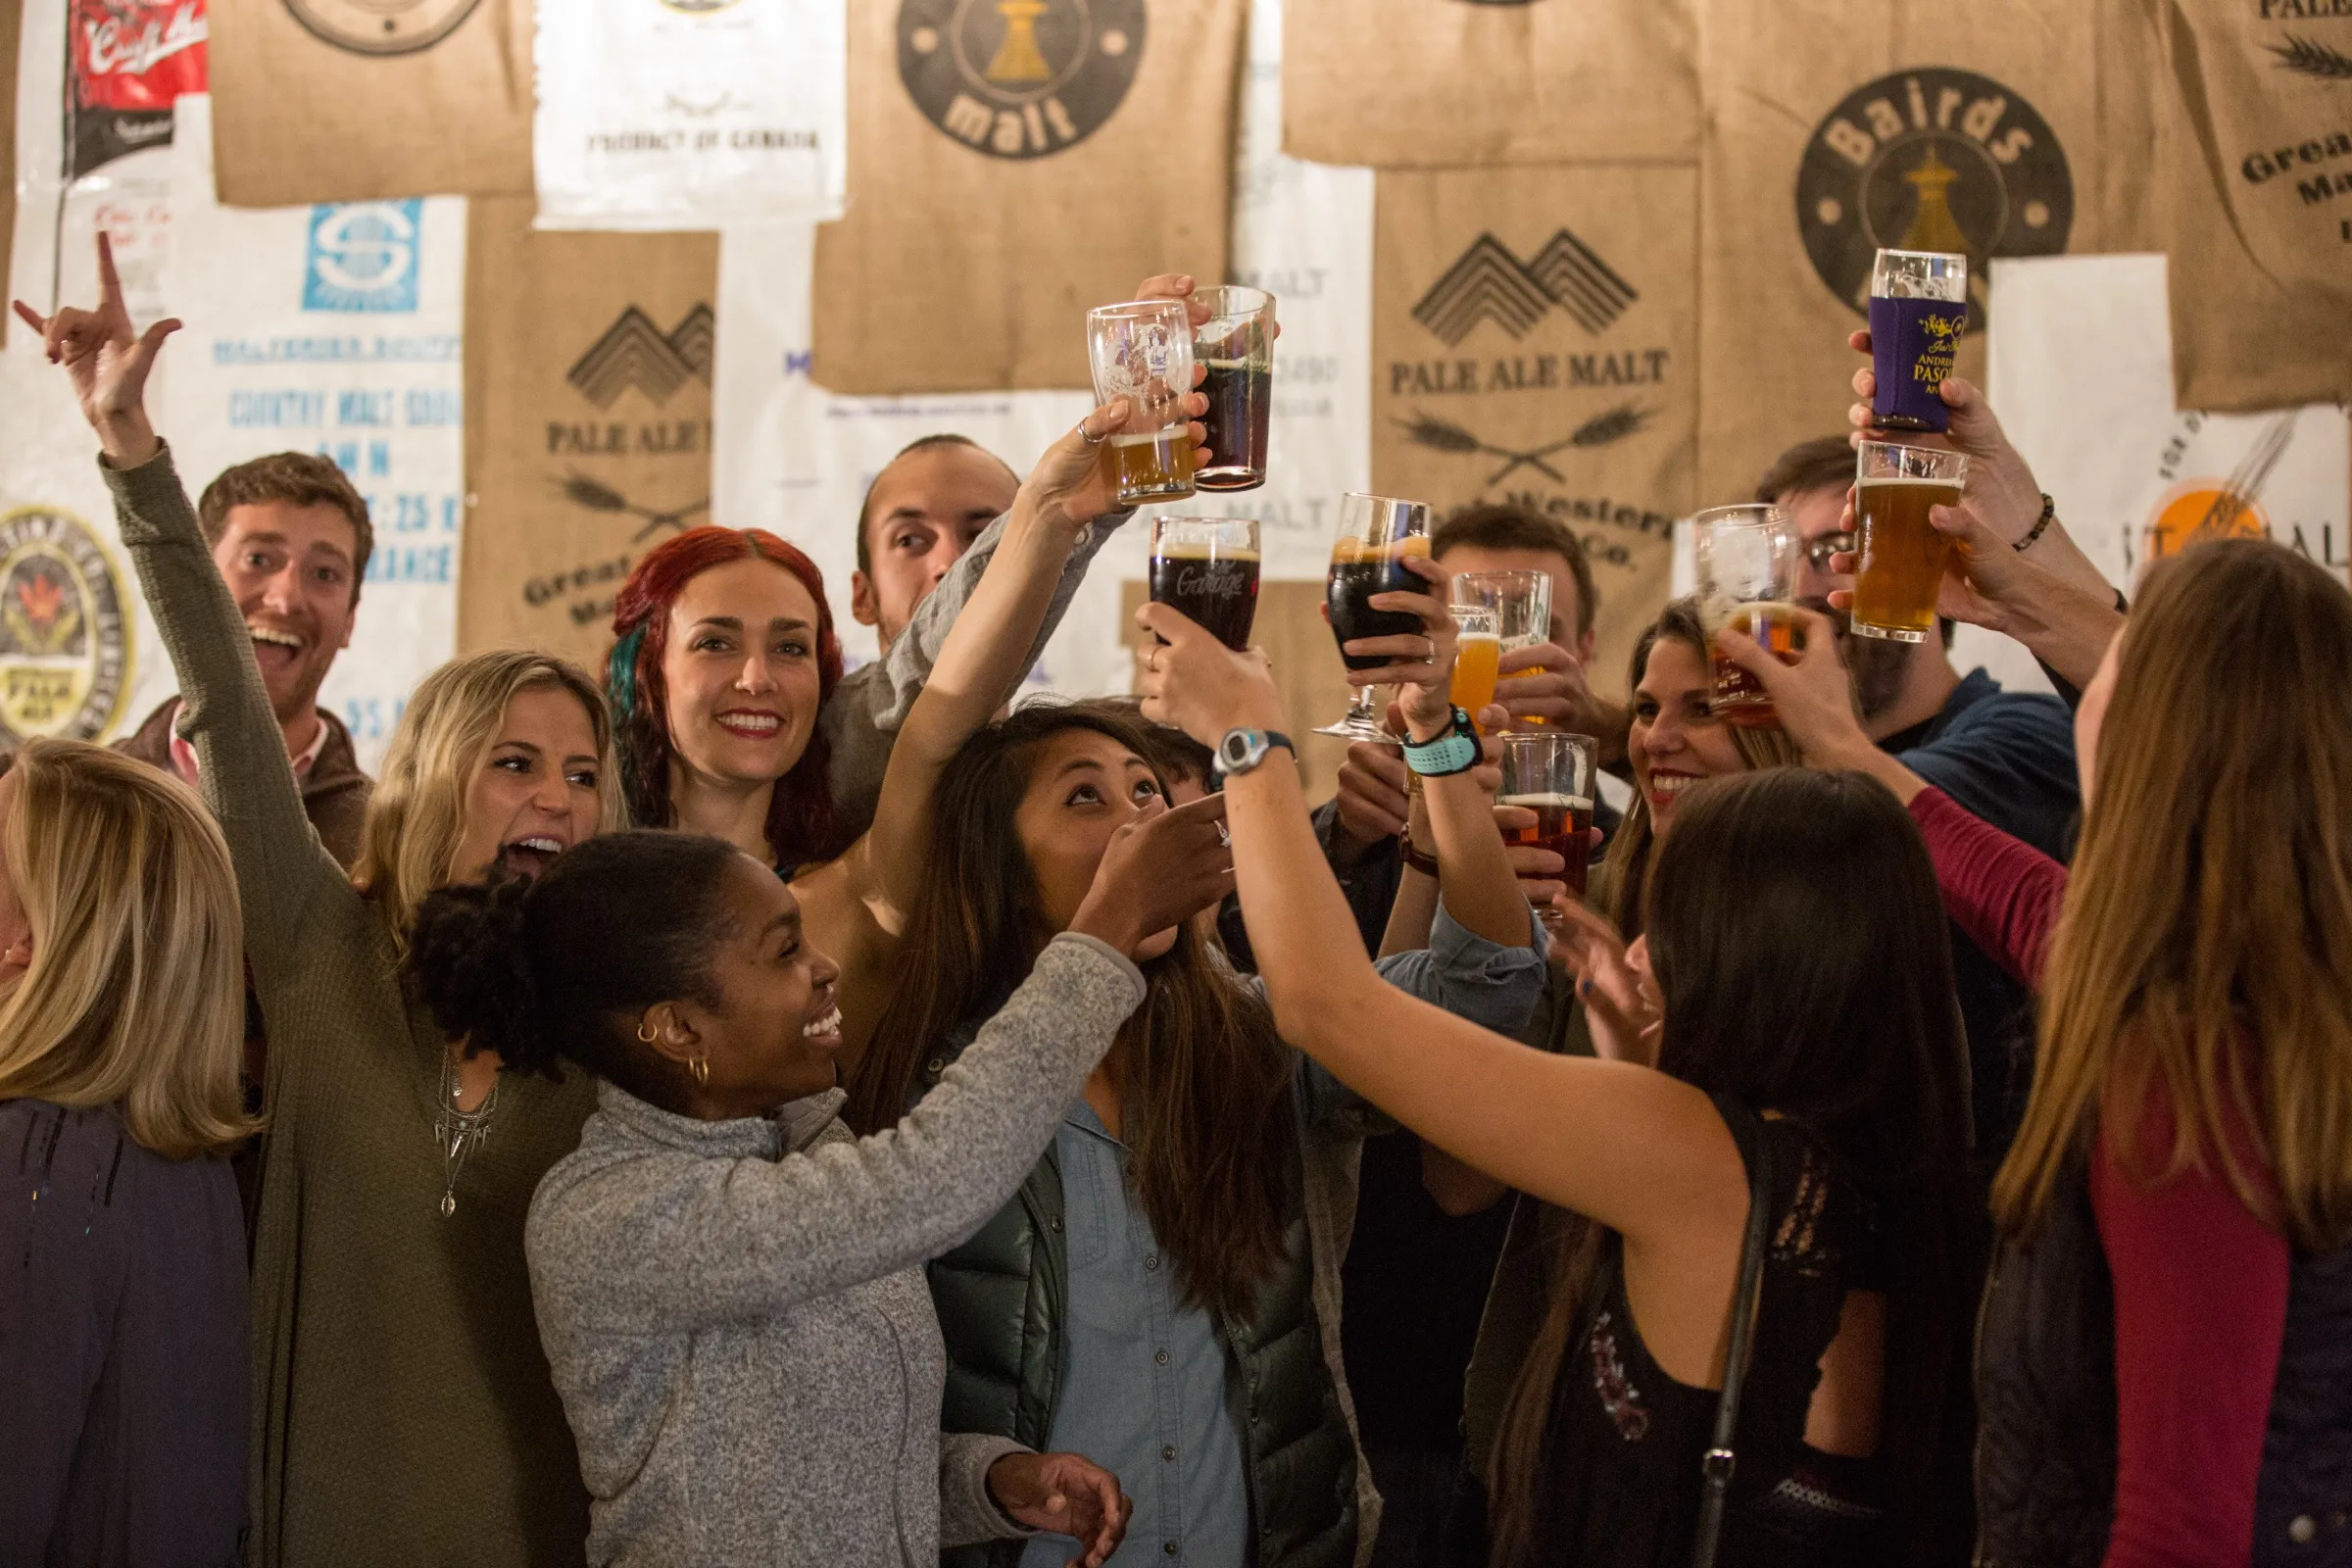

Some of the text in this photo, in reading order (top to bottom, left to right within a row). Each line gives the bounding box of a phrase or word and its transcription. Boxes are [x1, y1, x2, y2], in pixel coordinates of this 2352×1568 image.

[588, 127, 819, 152] PRODUCT OF CANADA
[943, 92, 1077, 154] malt
[1824, 76, 2034, 168] Bairds
[1389, 345, 1671, 396] PALE ALE MALT
[545, 419, 696, 454] PALE ALE
[523, 555, 630, 607] Great
